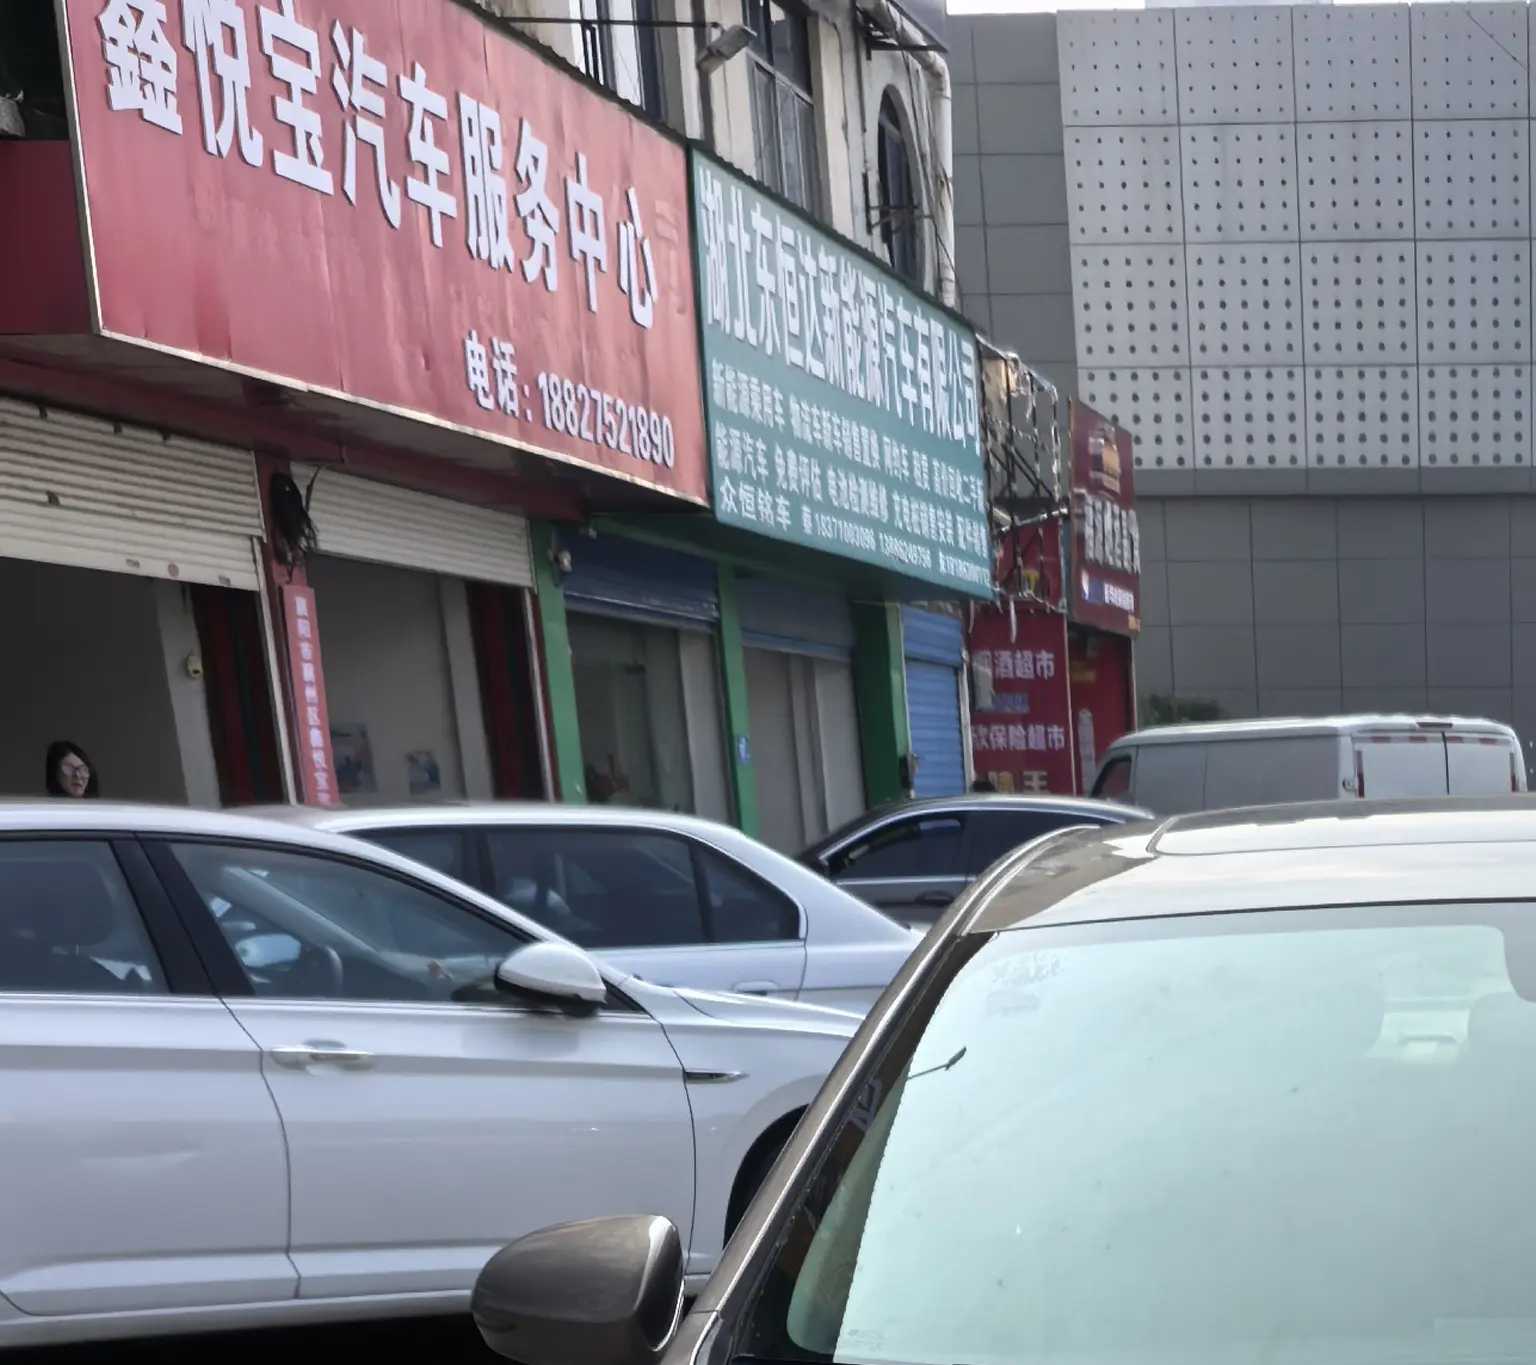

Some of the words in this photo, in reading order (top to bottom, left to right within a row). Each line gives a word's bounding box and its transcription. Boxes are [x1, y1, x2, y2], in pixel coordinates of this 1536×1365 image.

[97, 0, 657, 329] 鑫悦宝汽车服务中心
[700, 166, 981, 458] 湖北东恒达新能源汽车有限公司
